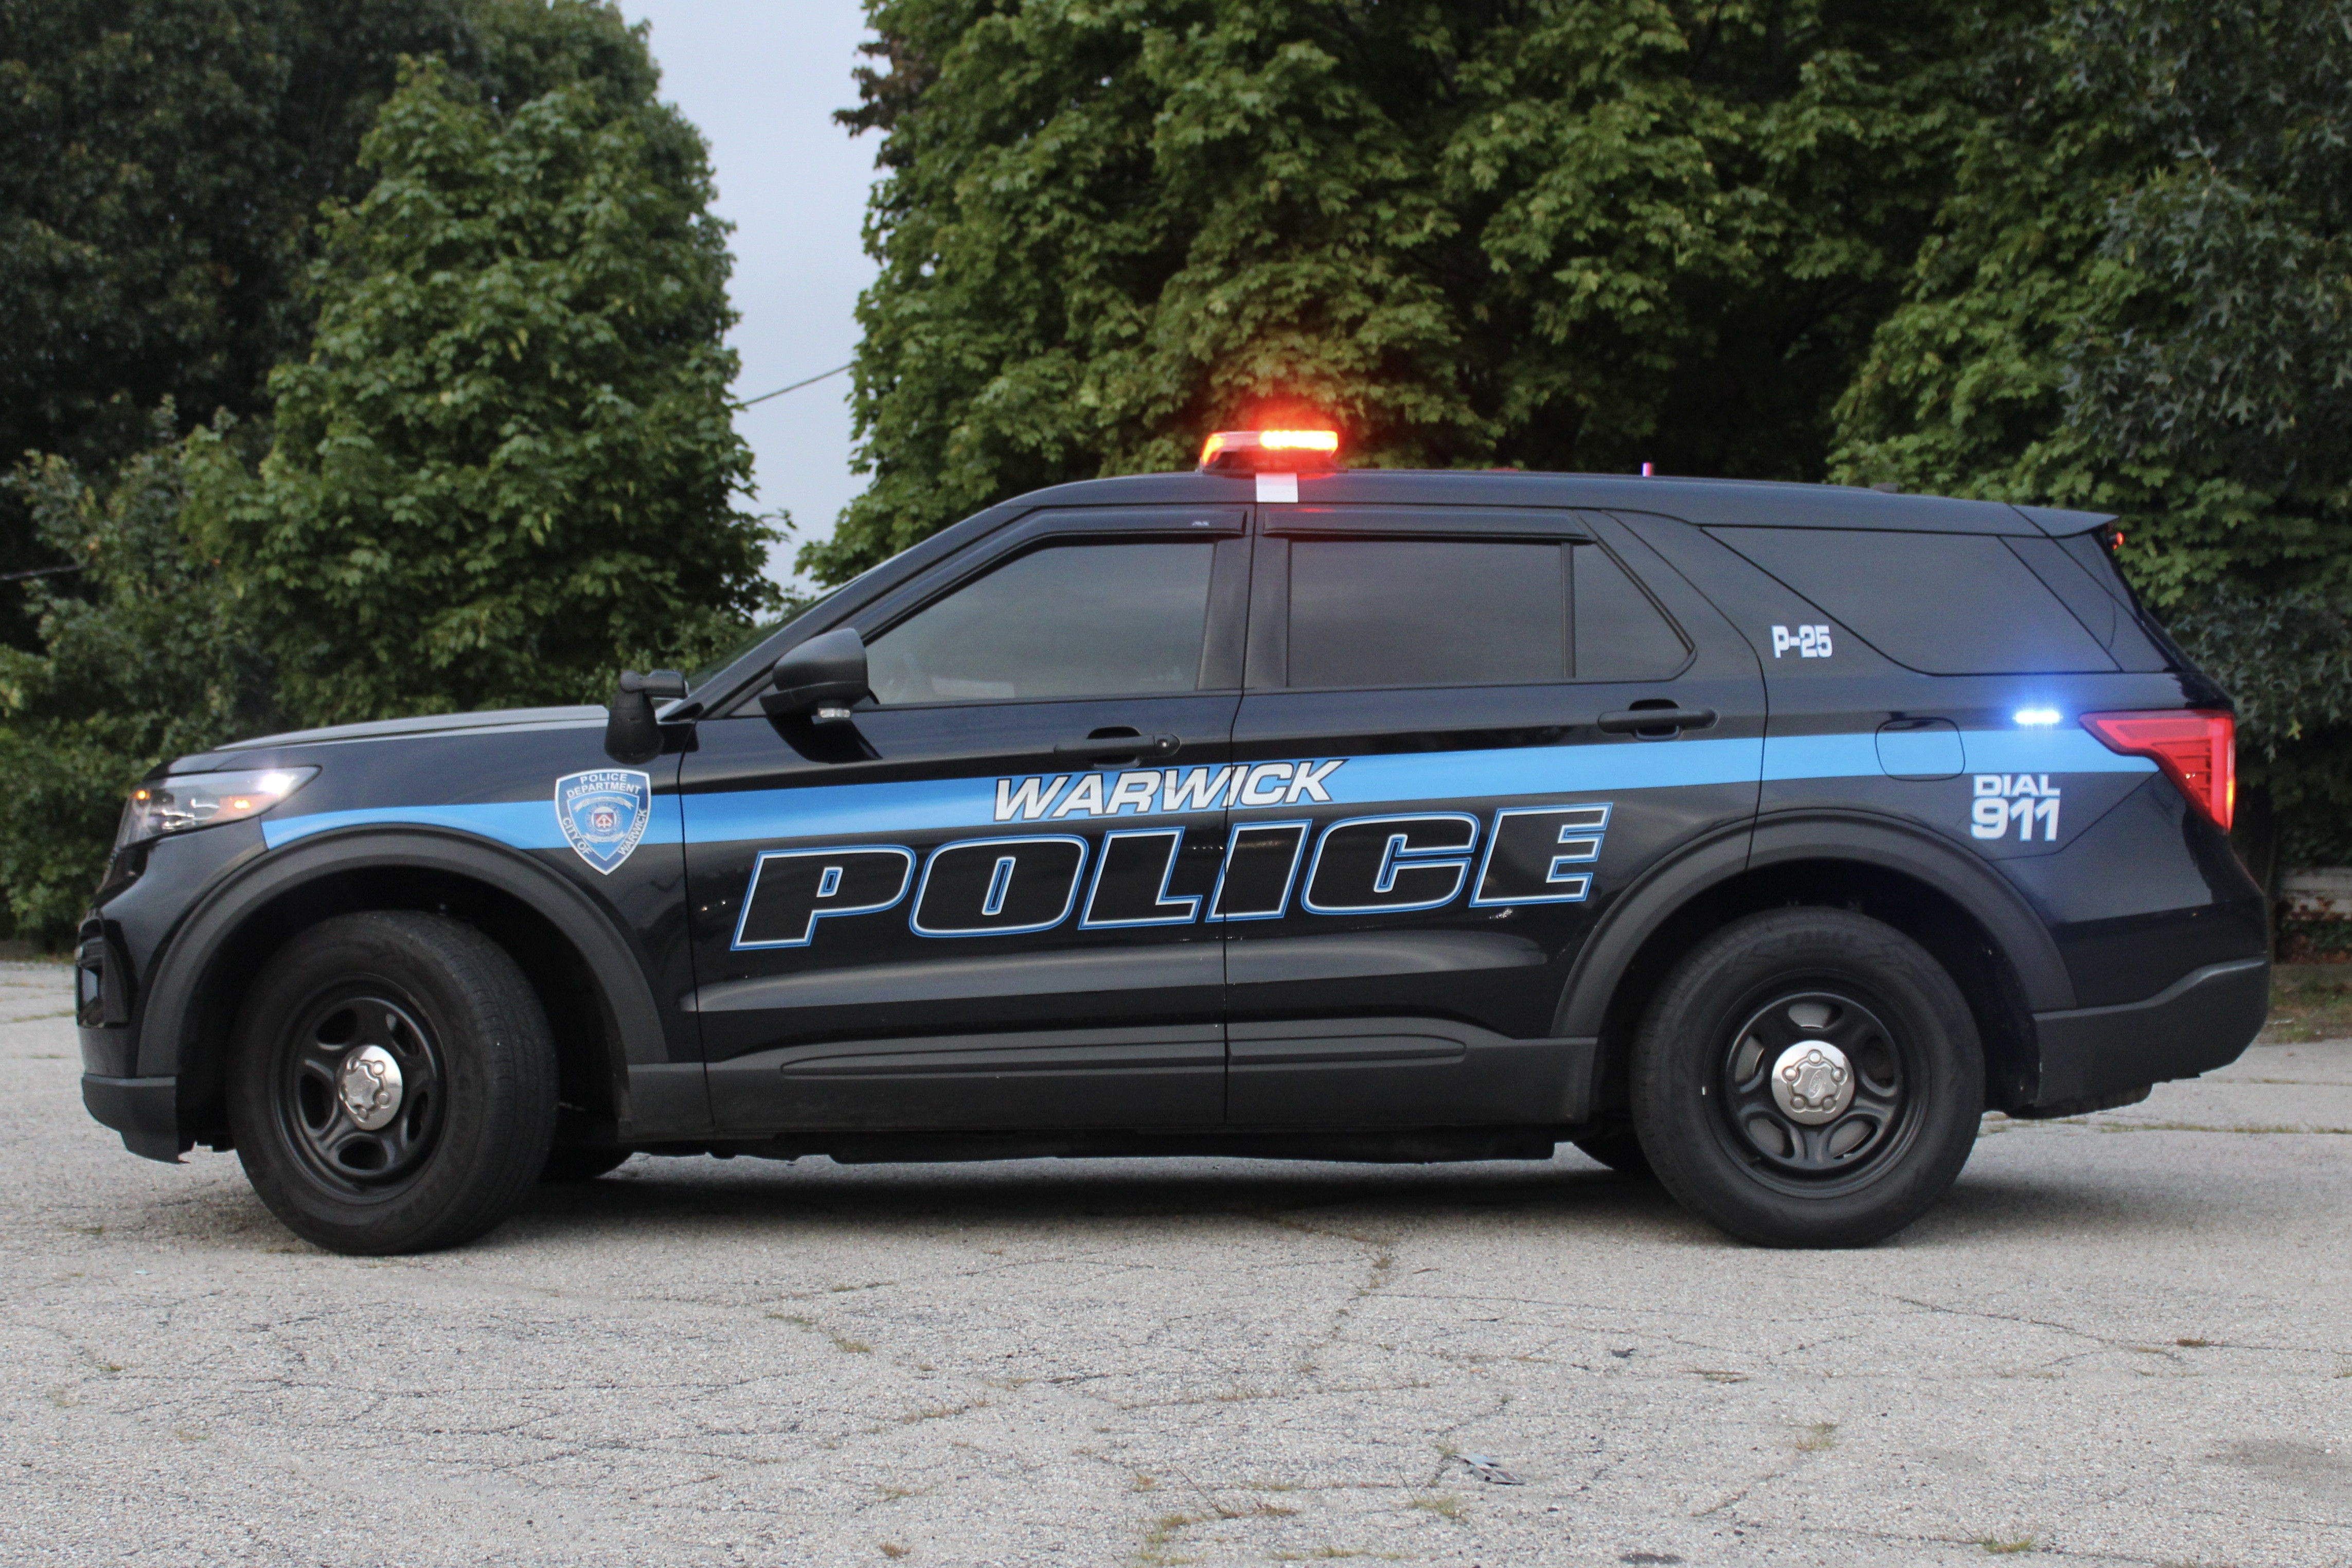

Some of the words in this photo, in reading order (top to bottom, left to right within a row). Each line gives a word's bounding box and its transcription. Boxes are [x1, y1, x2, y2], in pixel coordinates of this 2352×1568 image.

[1771, 625, 1833, 659] P-25
[566, 781, 642, 798] DEPARTMENT
[579, 772, 628, 785] POLICE
[993, 758, 1349, 822] WARWICK
[1973, 774, 2061, 797] DIAL
[563, 817, 581, 841] CITY
[577, 842, 592, 855] OF
[617, 808, 648, 856] WARWICK
[1970, 797, 2060, 842] 911
[730, 802, 1612, 951] POLICE
